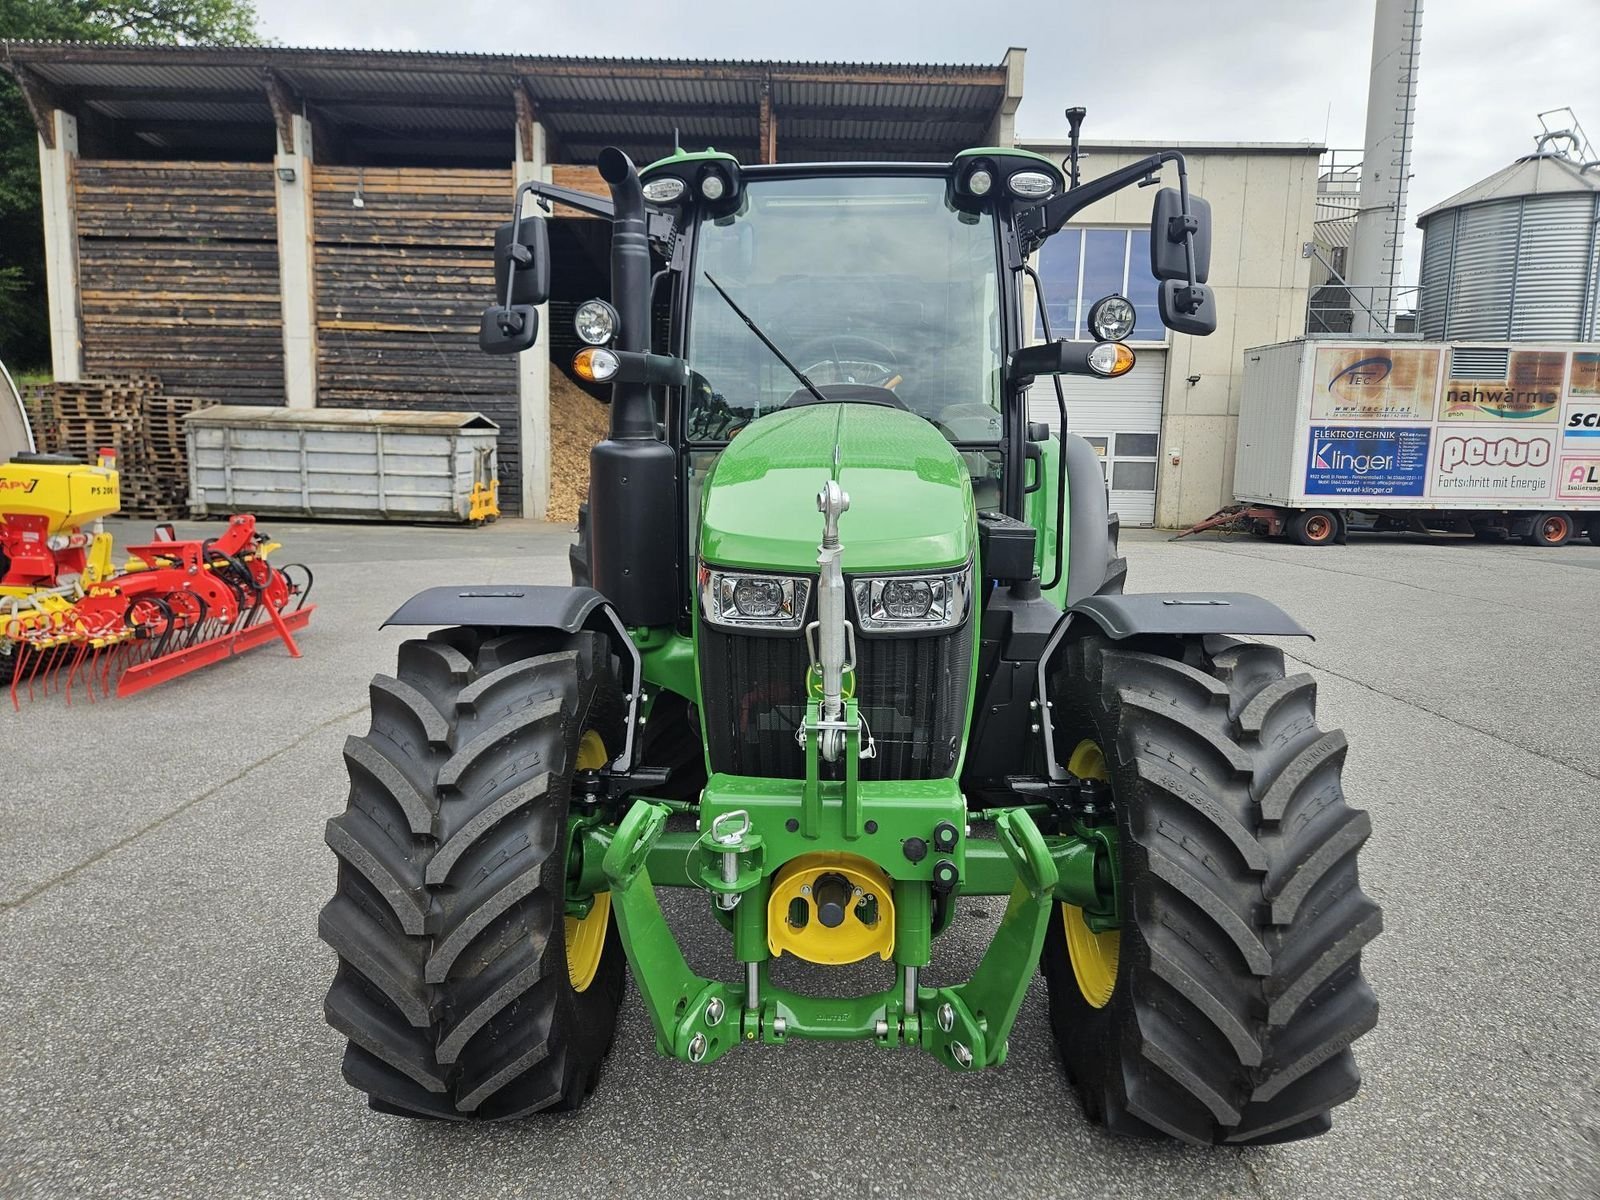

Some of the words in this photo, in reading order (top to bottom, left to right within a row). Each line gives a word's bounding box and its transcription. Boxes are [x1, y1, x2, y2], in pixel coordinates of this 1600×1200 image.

[1348, 372, 1377, 385] TEC
[1446, 387, 1557, 404] nahwärme
[1314, 430, 1396, 439] ELEKTROTECHNIK
[1312, 439, 1393, 474] Klinger
[1493, 476, 1508, 488] mit
[1511, 475, 1546, 491] Energie
[1336, 486, 1393, 495] www.et-klinger.at
